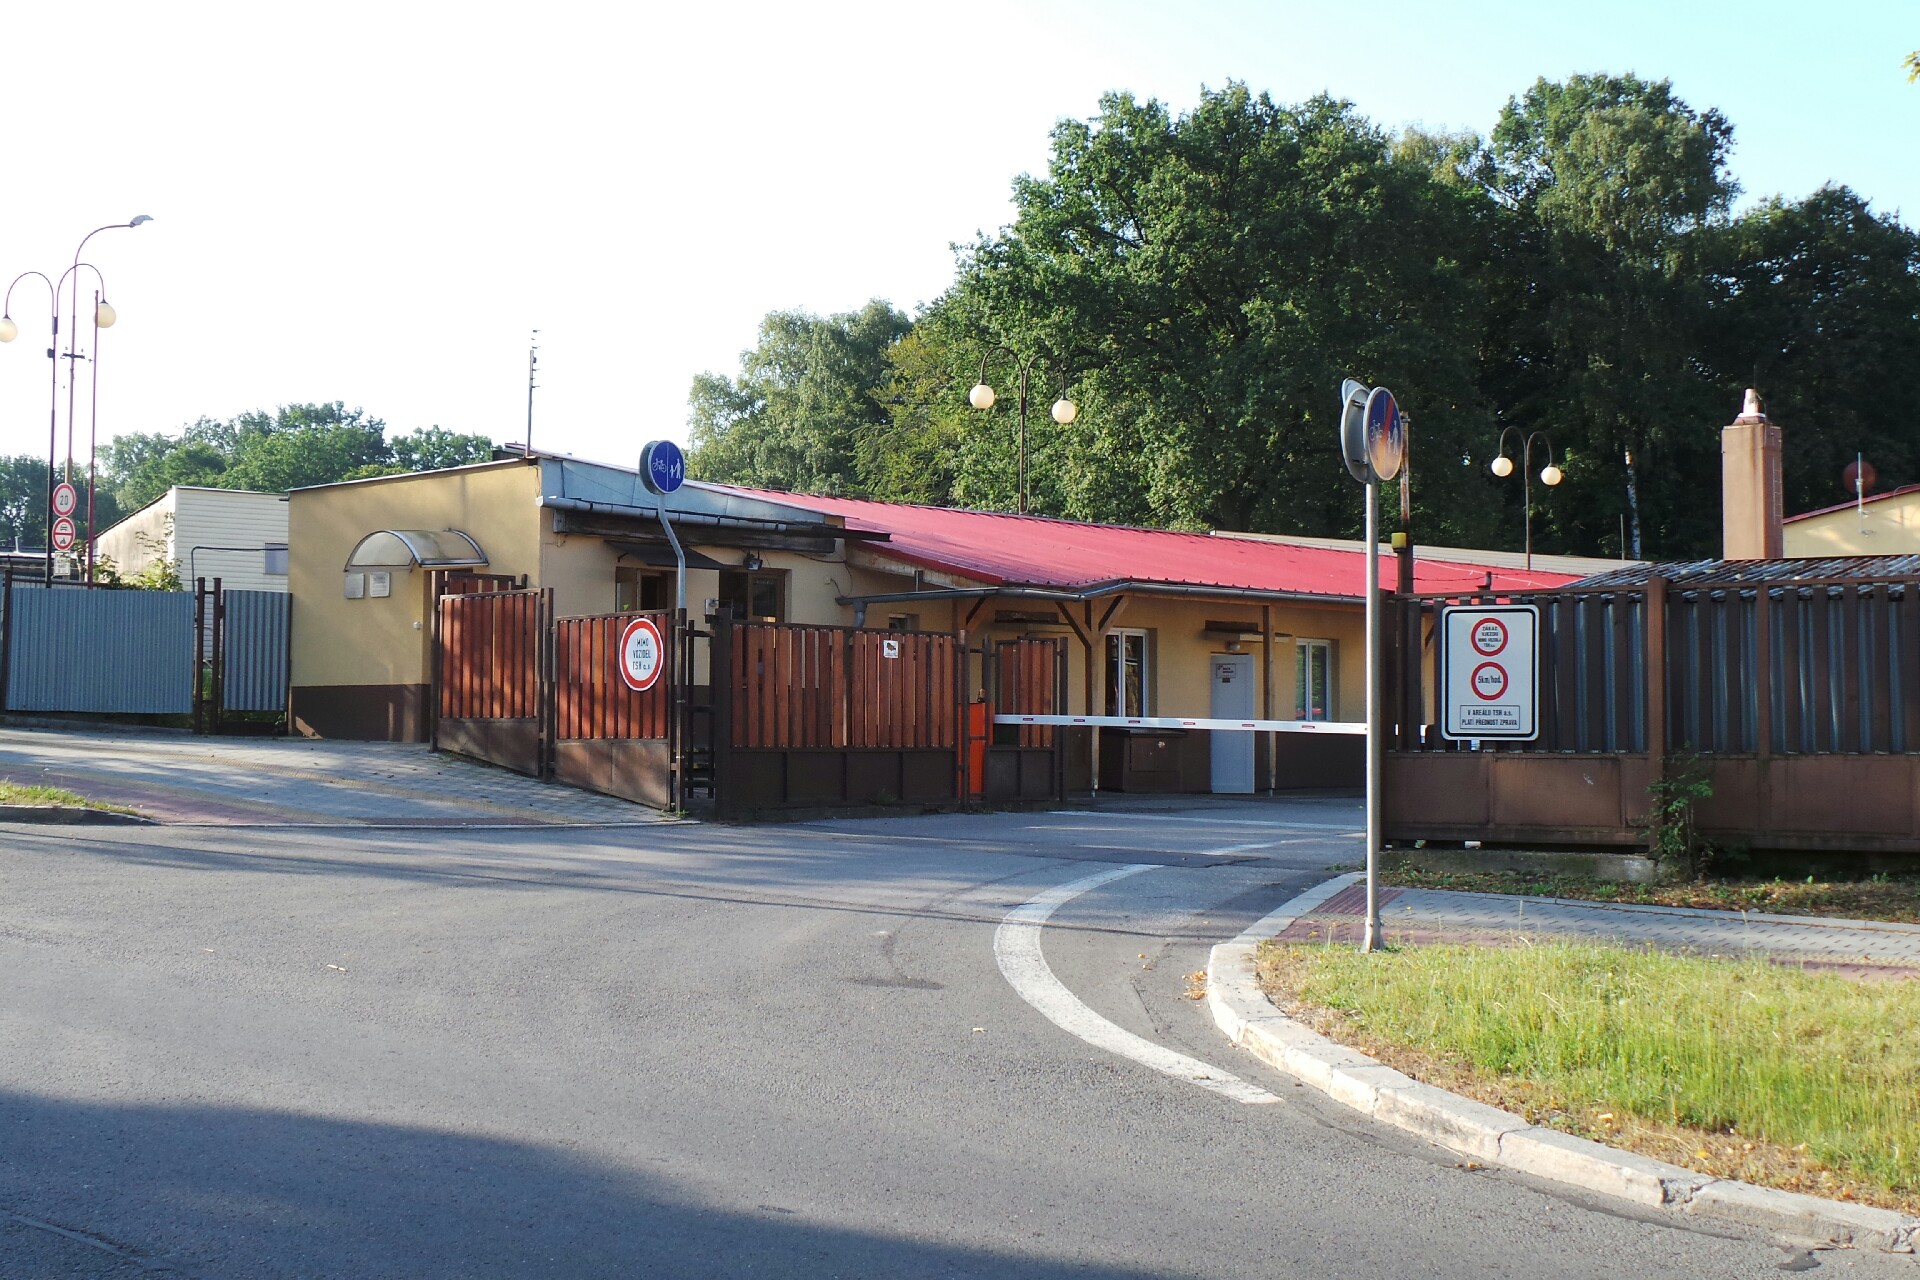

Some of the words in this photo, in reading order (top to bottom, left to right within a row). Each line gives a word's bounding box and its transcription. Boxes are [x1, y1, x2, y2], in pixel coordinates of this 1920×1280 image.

[60, 495, 69, 506] 20
[636, 638, 649, 647] MIMO
[632, 650, 652, 659] VOZIDEL
